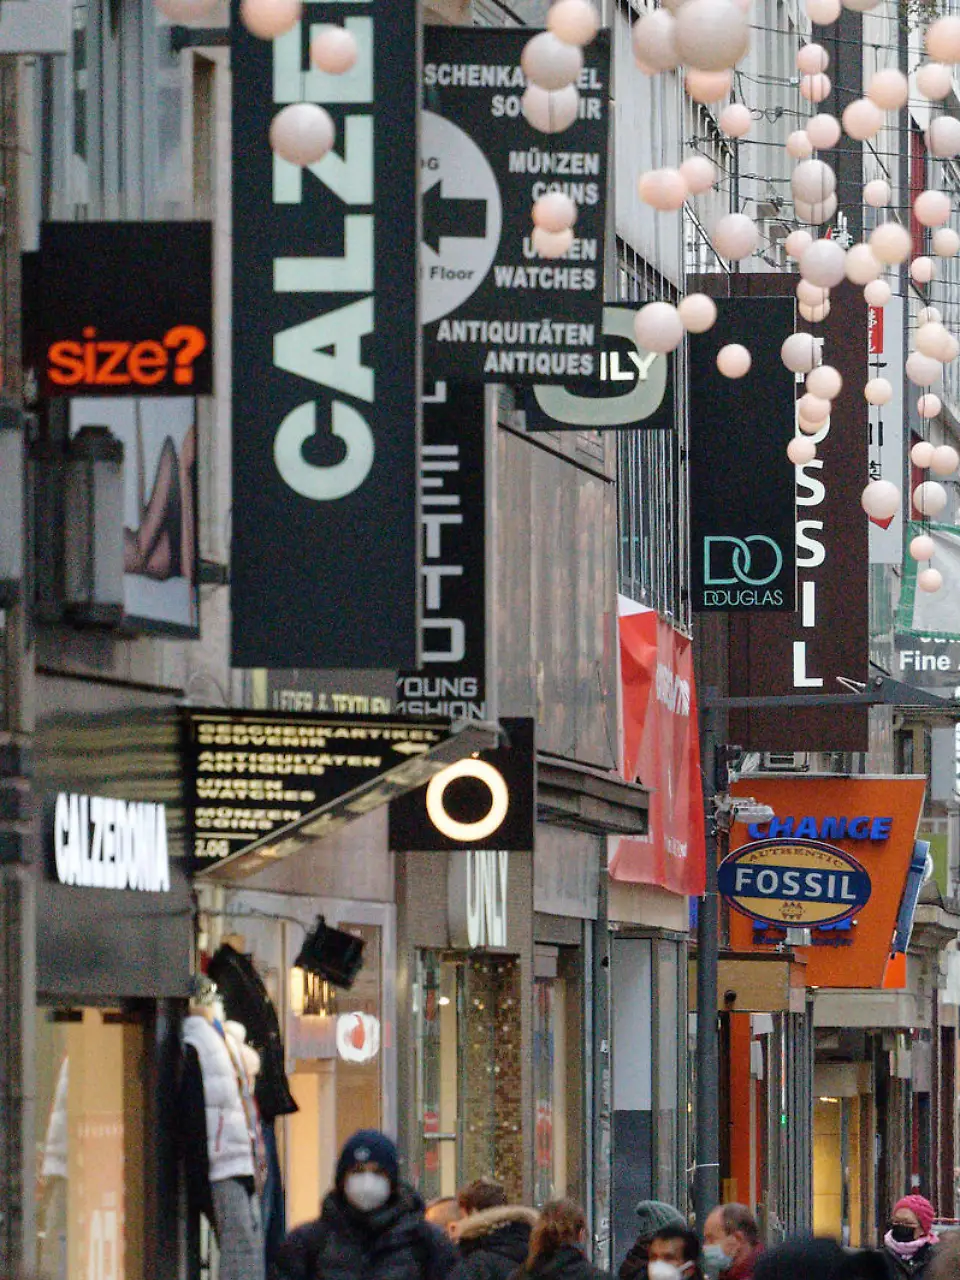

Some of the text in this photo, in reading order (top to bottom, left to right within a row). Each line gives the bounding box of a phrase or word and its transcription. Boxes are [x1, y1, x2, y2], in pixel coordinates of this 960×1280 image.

[491, 95, 601, 119] SOIR
[508, 148, 600, 174] MÜNZEN
[273, 0, 373, 500] CALZE
[522, 238, 597, 260] UEN
[429, 266, 475, 280] Floor
[493, 266, 597, 290] WATCHES
[436, 319, 595, 345] ANTIQUITÄTEN
[48, 325, 206, 386] size?
[484, 352, 594, 377] ANTIQUES
[704, 590, 784, 606] DOUGLAS
[899, 650, 952, 671] Fine
[396, 677, 479, 699] OUNG
[747, 815, 894, 841] CHANGE
[749, 847, 843, 869] AUTHENTIC
[735, 867, 858, 901] FOSSIL
